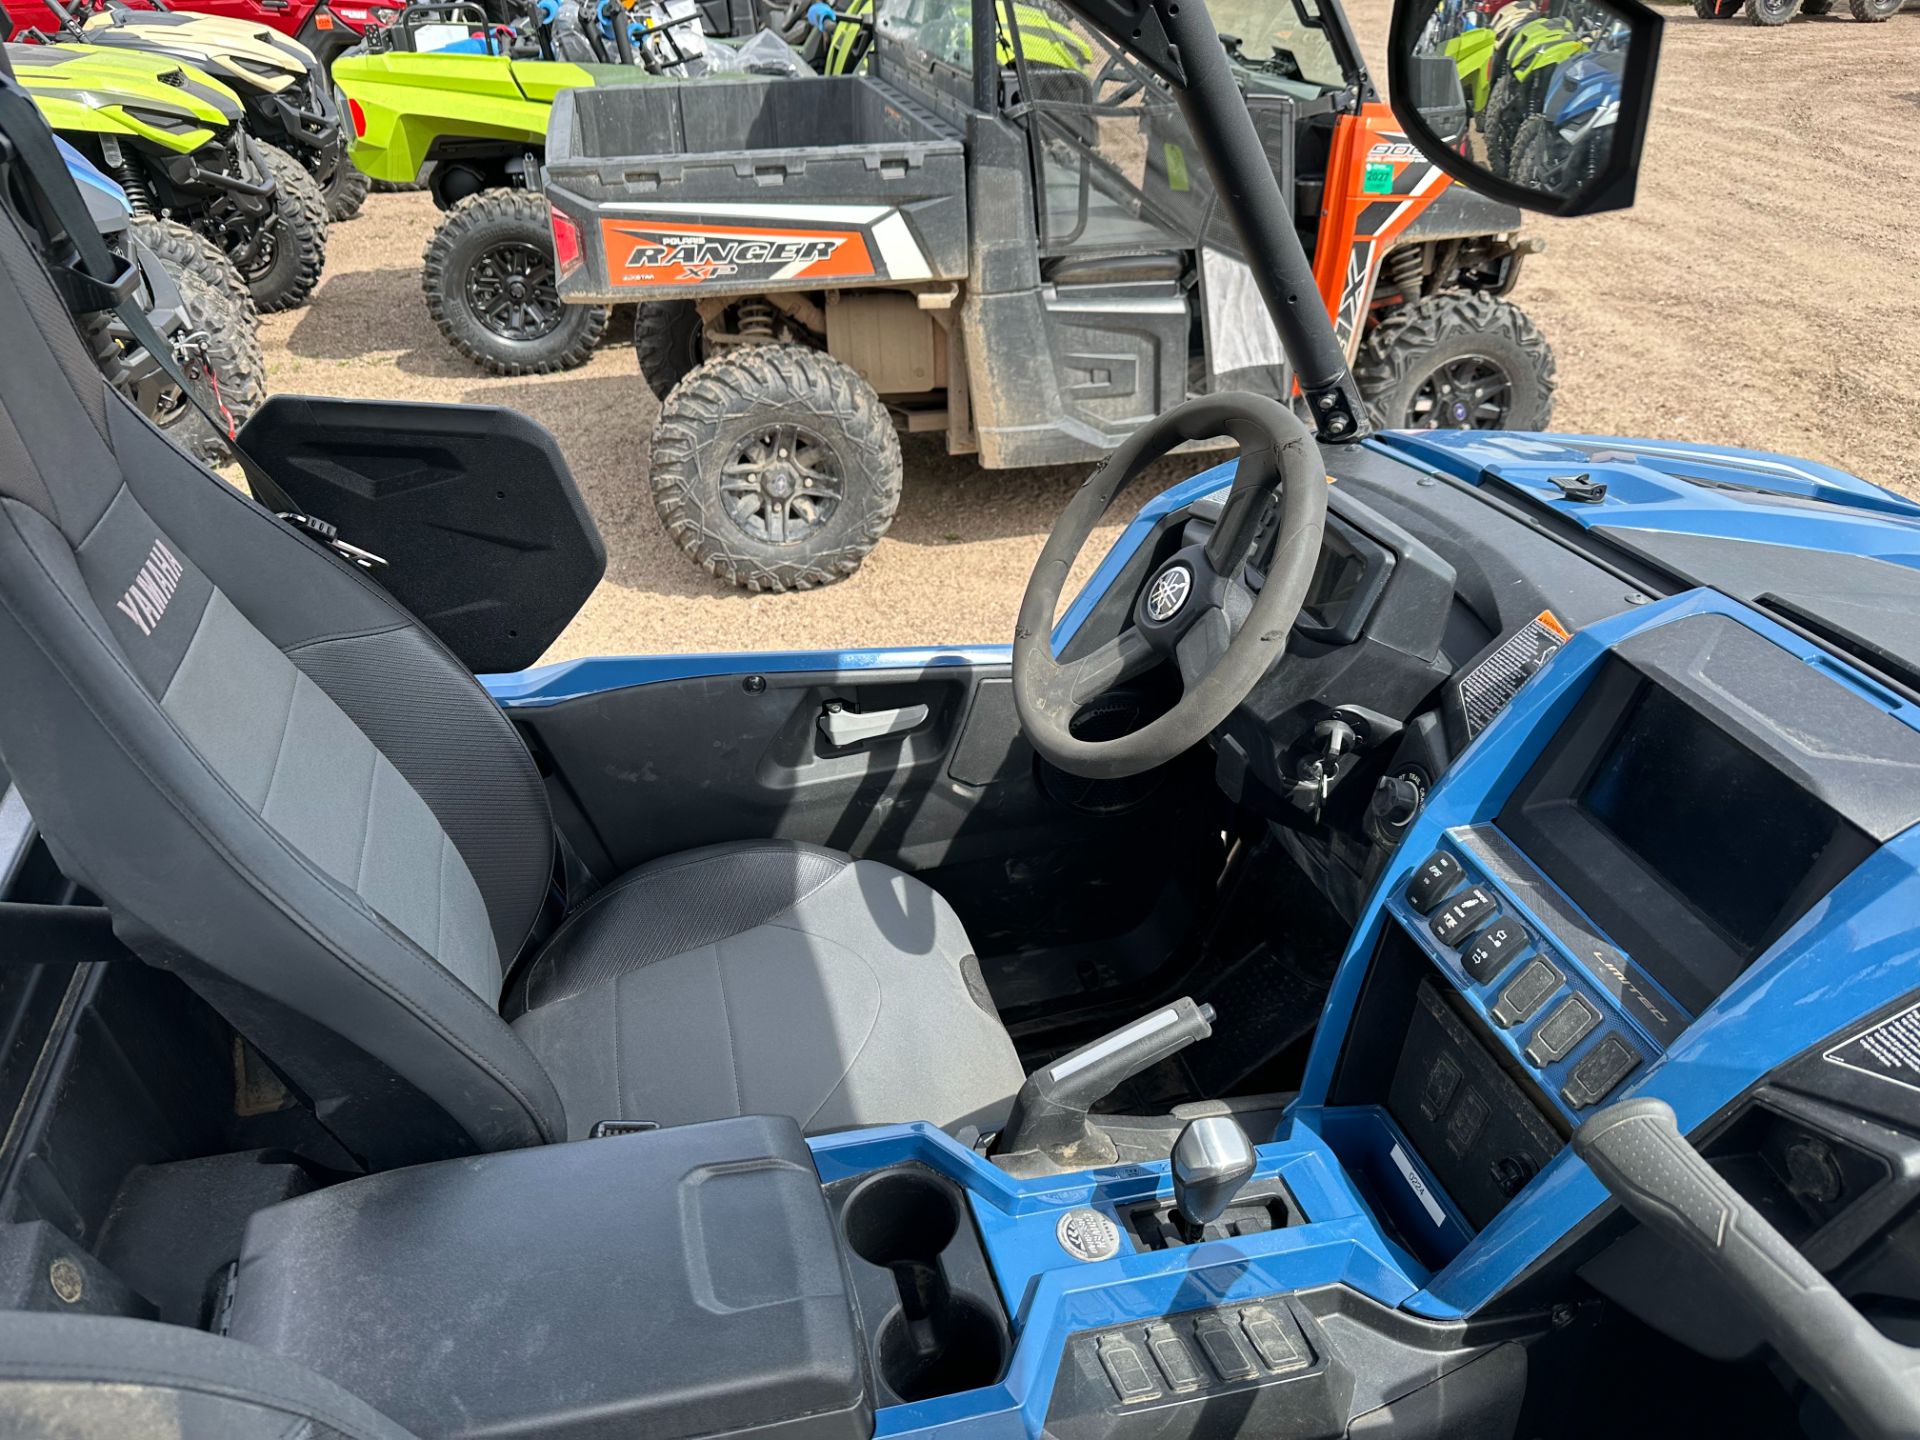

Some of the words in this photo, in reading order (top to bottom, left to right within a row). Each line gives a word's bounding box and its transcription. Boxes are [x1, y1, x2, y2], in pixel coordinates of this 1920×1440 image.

[662, 236, 706, 246] POLARIS
[625, 241, 839, 267] RANGER
[674, 264, 738, 280] XP
[116, 538, 184, 636] YAMAHA
[1593, 951, 1669, 1023] LIMITED
[1408, 1171, 1426, 1196] 0224
